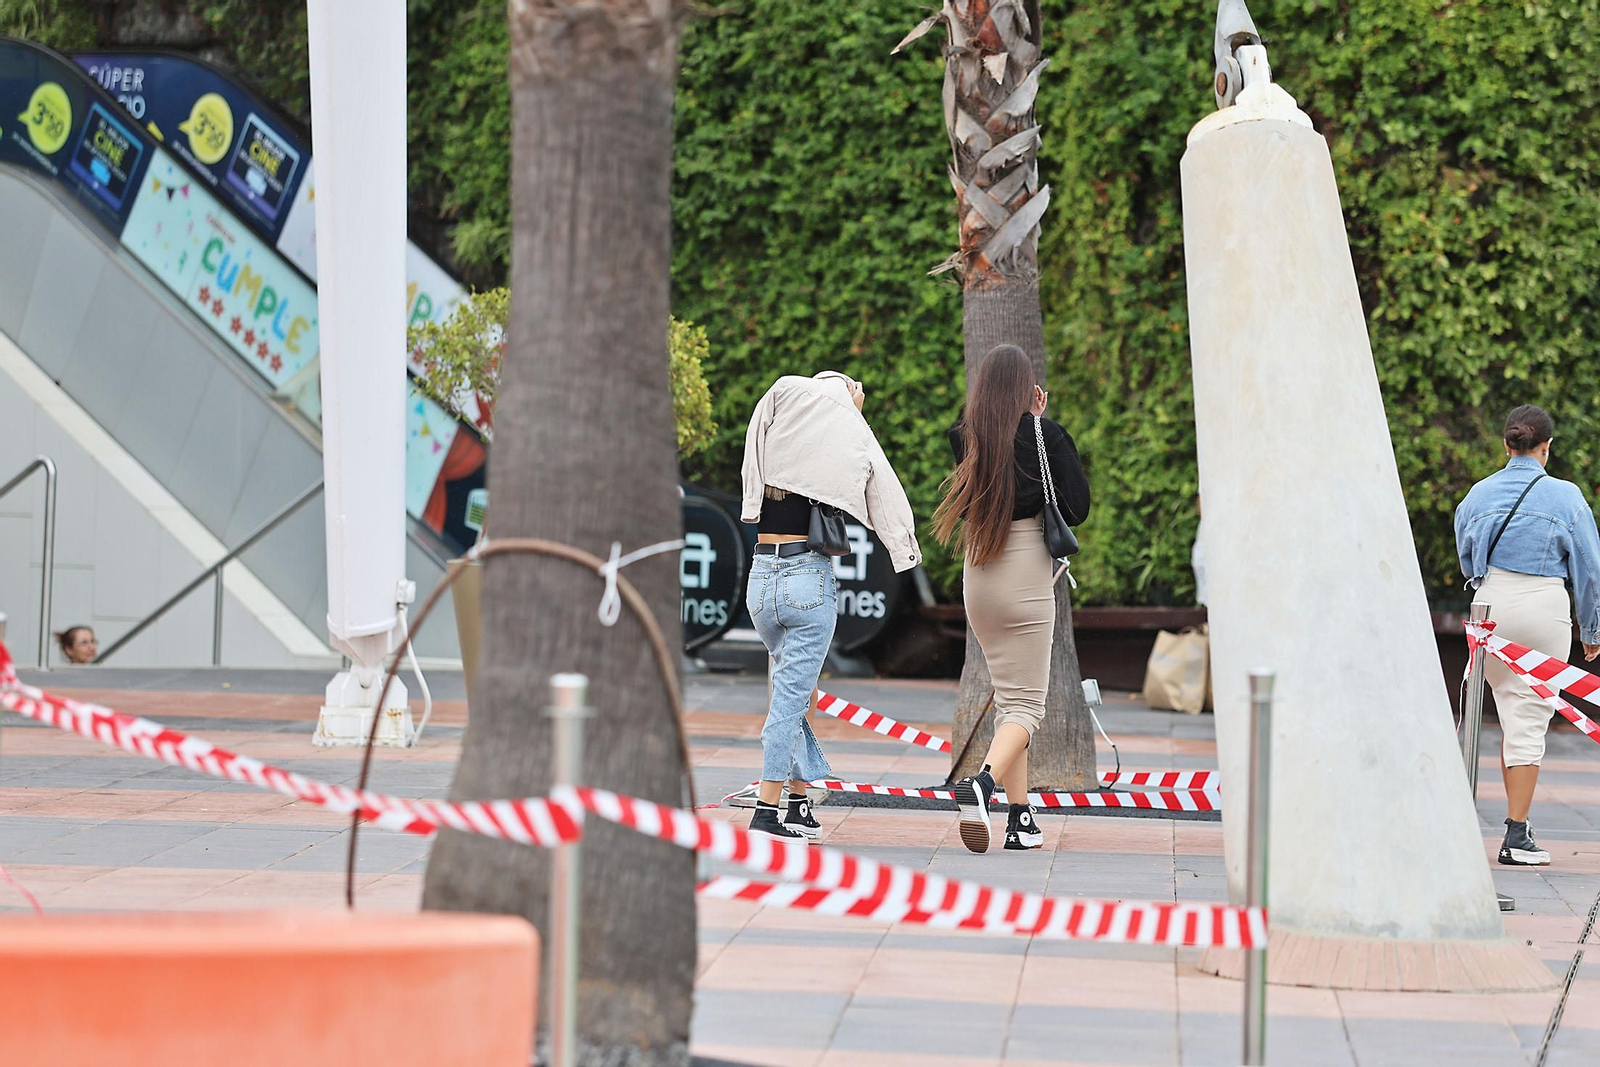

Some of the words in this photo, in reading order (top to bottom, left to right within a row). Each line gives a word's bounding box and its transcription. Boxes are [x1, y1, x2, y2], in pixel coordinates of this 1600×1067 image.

[202, 237, 310, 354] CUMPLE
[680, 590, 728, 626] ines
[836, 581, 886, 618] ines
